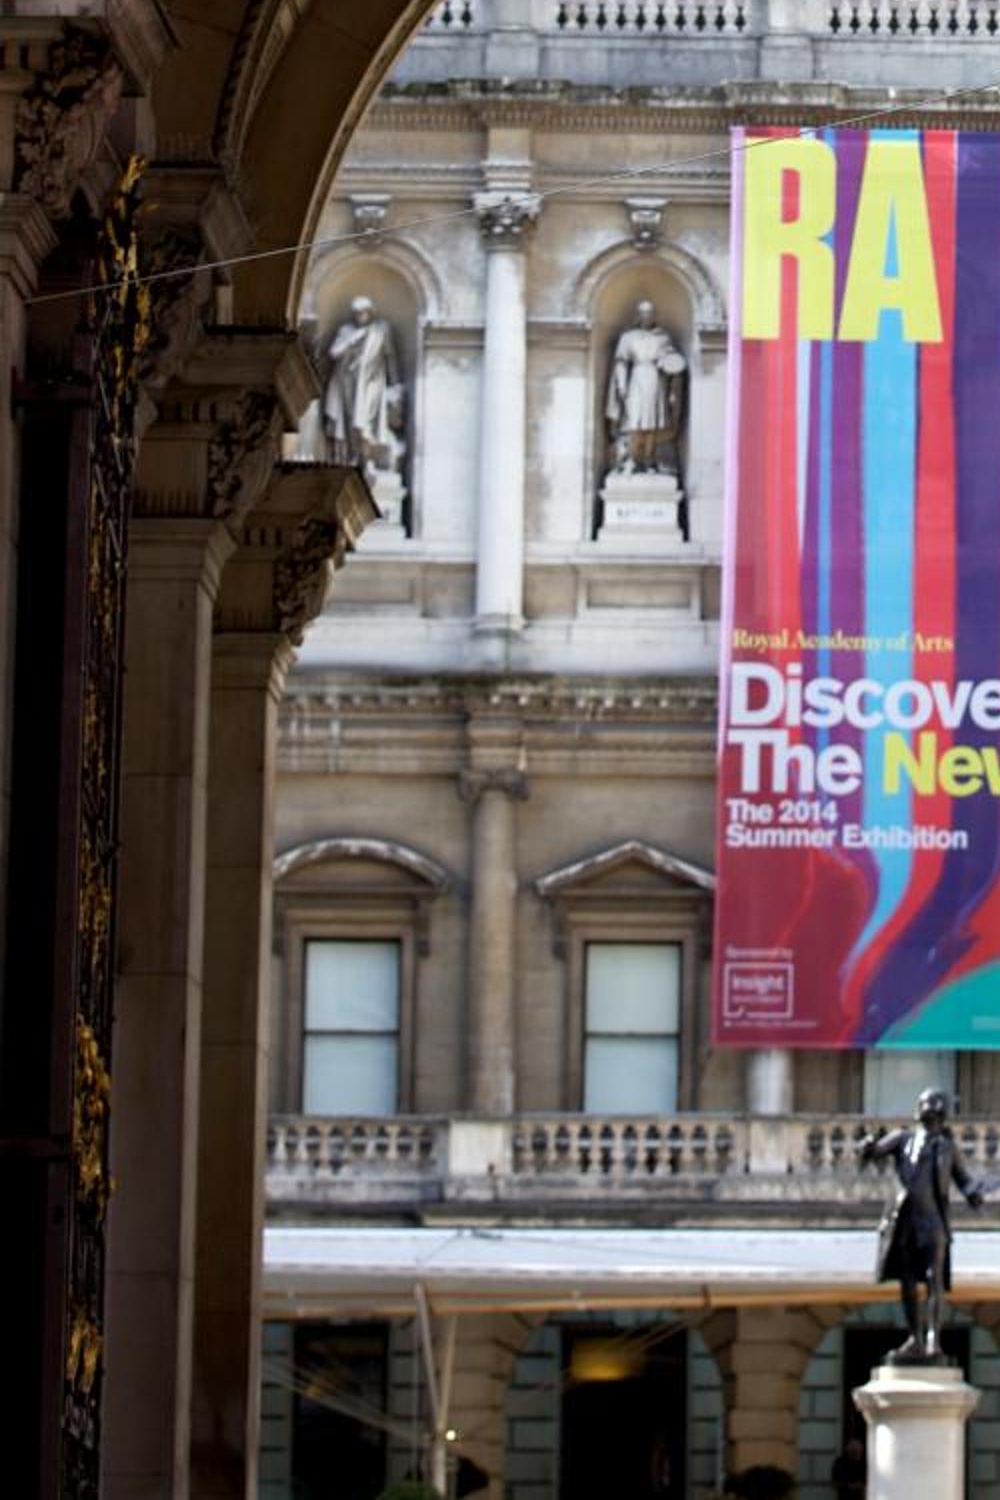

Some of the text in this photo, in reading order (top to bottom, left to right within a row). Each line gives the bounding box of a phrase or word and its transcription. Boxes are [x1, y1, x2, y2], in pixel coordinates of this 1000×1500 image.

[741, 136, 943, 343] RA
[733, 628, 789, 653] Royal
[792, 629, 884, 653] Academy
[912, 632, 955, 651] Arts
[727, 728, 863, 794] The
[726, 799, 838, 824] The 2014
[725, 823, 969, 849] Summer Exhibition
